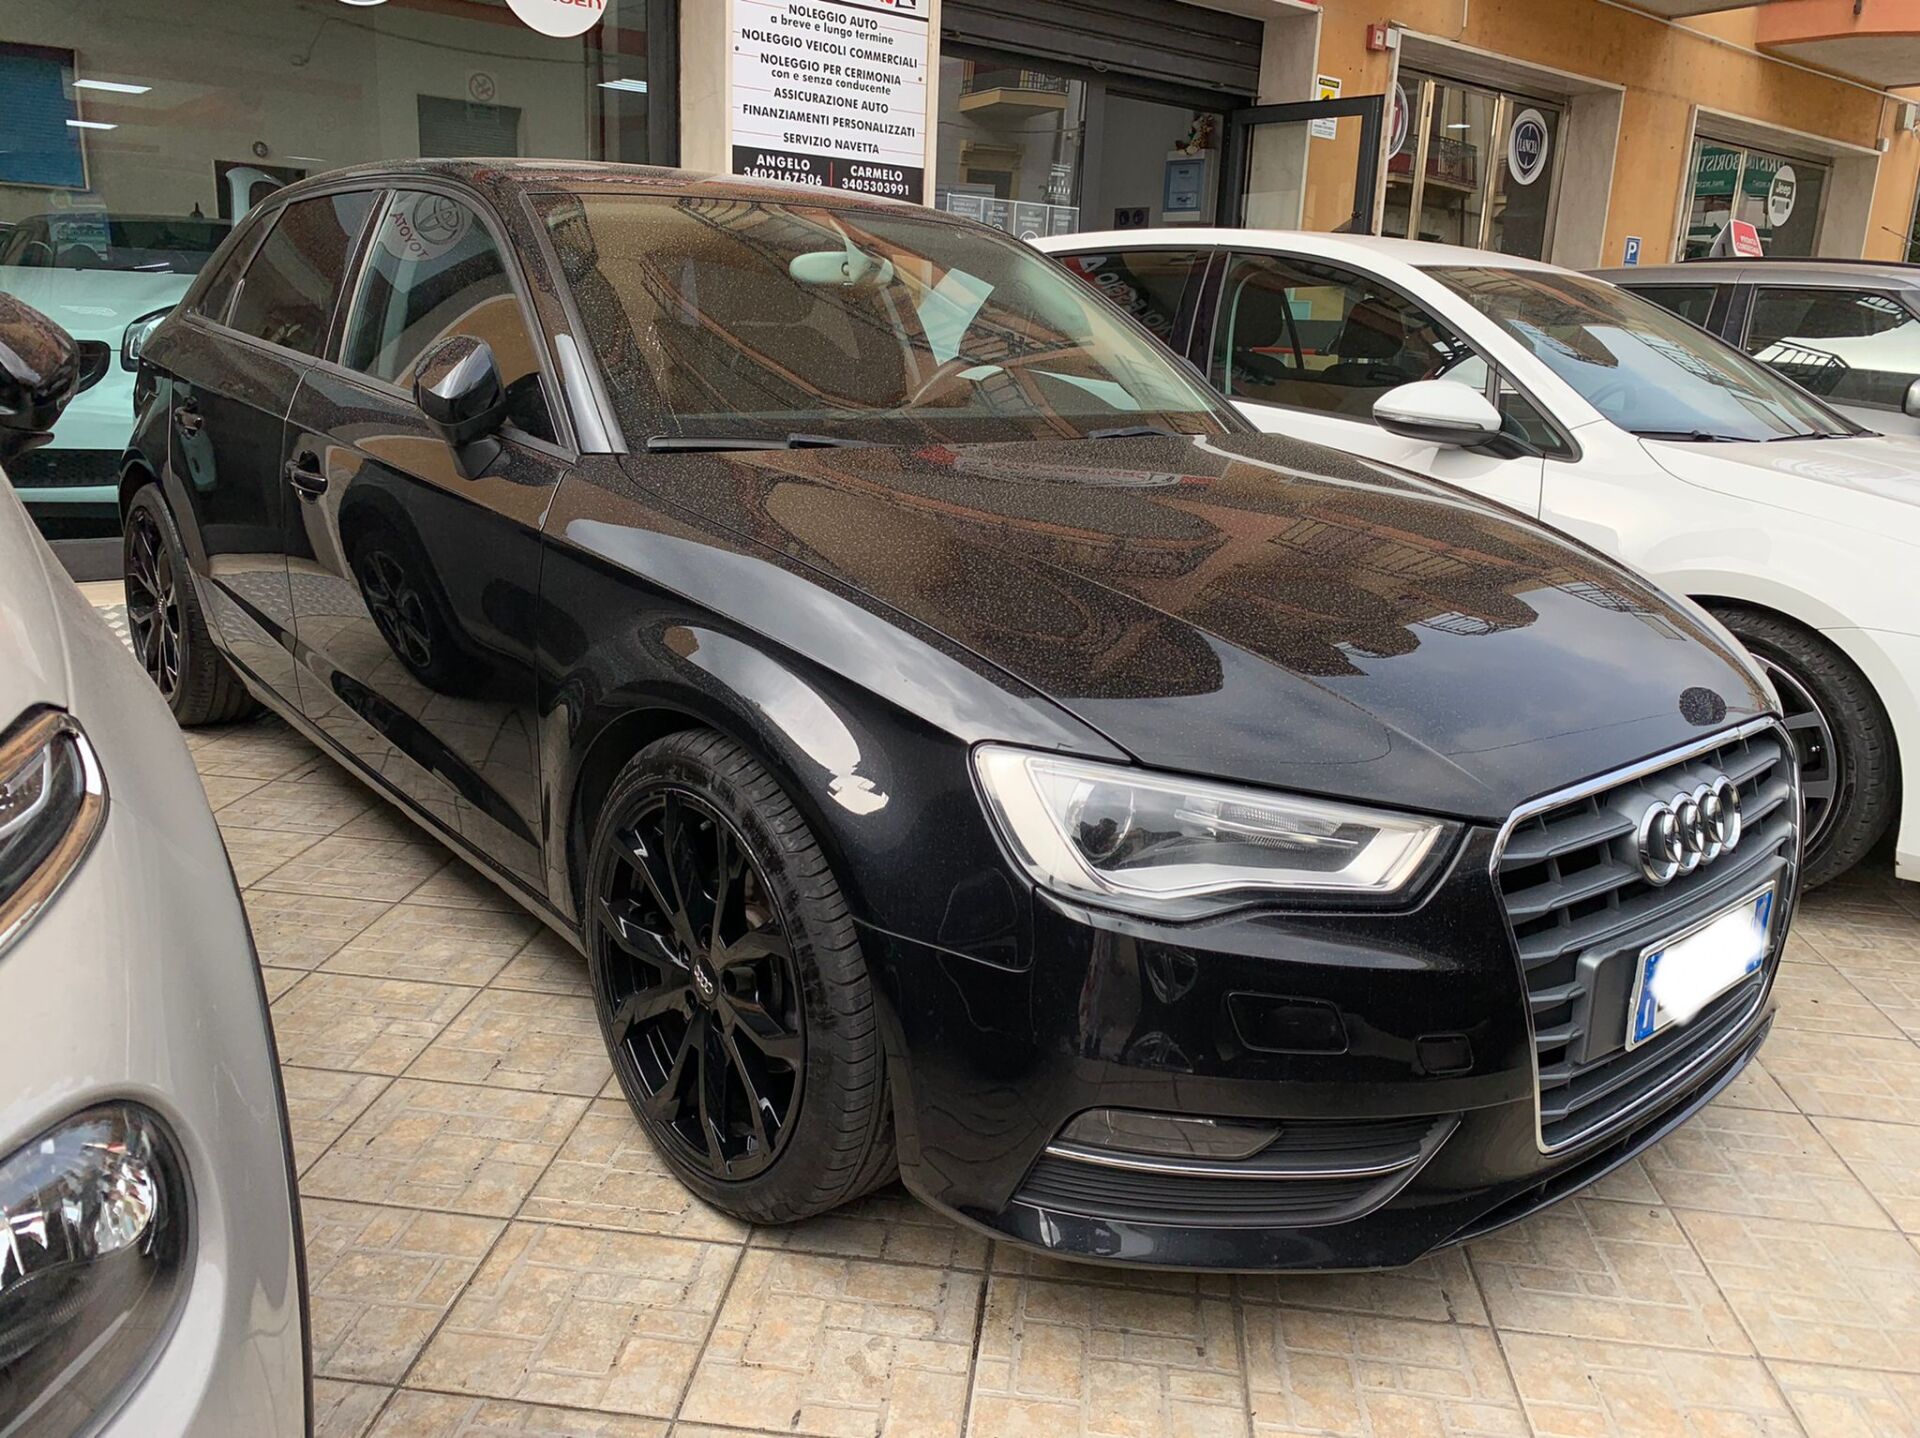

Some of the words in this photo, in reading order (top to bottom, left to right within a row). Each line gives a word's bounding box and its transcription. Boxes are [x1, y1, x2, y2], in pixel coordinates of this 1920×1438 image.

[788, 4, 847, 24] NOLEGGIO
[850, 16, 878, 30] AUTO
[770, 15, 778, 24] a
[781, 14, 811, 30] breve
[814, 23, 821, 32] e
[823, 22, 852, 38] lungo
[855, 30, 893, 45] termine
[741, 28, 802, 48] NOLEGGIO
[806, 39, 846, 55] VEICOLI
[849, 47, 917, 68] COMMERCIALI
[760, 52, 820, 72] NOLEGGIO
[823, 63, 841, 76] PER
[844, 67, 901, 86] CERIMONIA
[771, 69, 790, 79] con
[792, 72, 799, 81] e
[802, 74, 832, 86] senza
[835, 79, 892, 95] conducente
[773, 87, 858, 109] ASSICURAZIONE
[860, 100, 889, 114] AUTO
[742, 103, 829, 125] FINANZIAMENTI
[832, 116, 915, 137] PERSONALIZZATI
[783, 132, 832, 148] SERVIZIO
[834, 138, 880, 154] NAVETTA
[756, 153, 811, 171] ANGELO
[850, 165, 903, 182] CARMELO
[743, 166, 823, 186] 3402167506
[842, 177, 909, 195] 3405303991
[1775, 181, 1793, 198] Jeep
[1627, 241, 1638, 259] P
